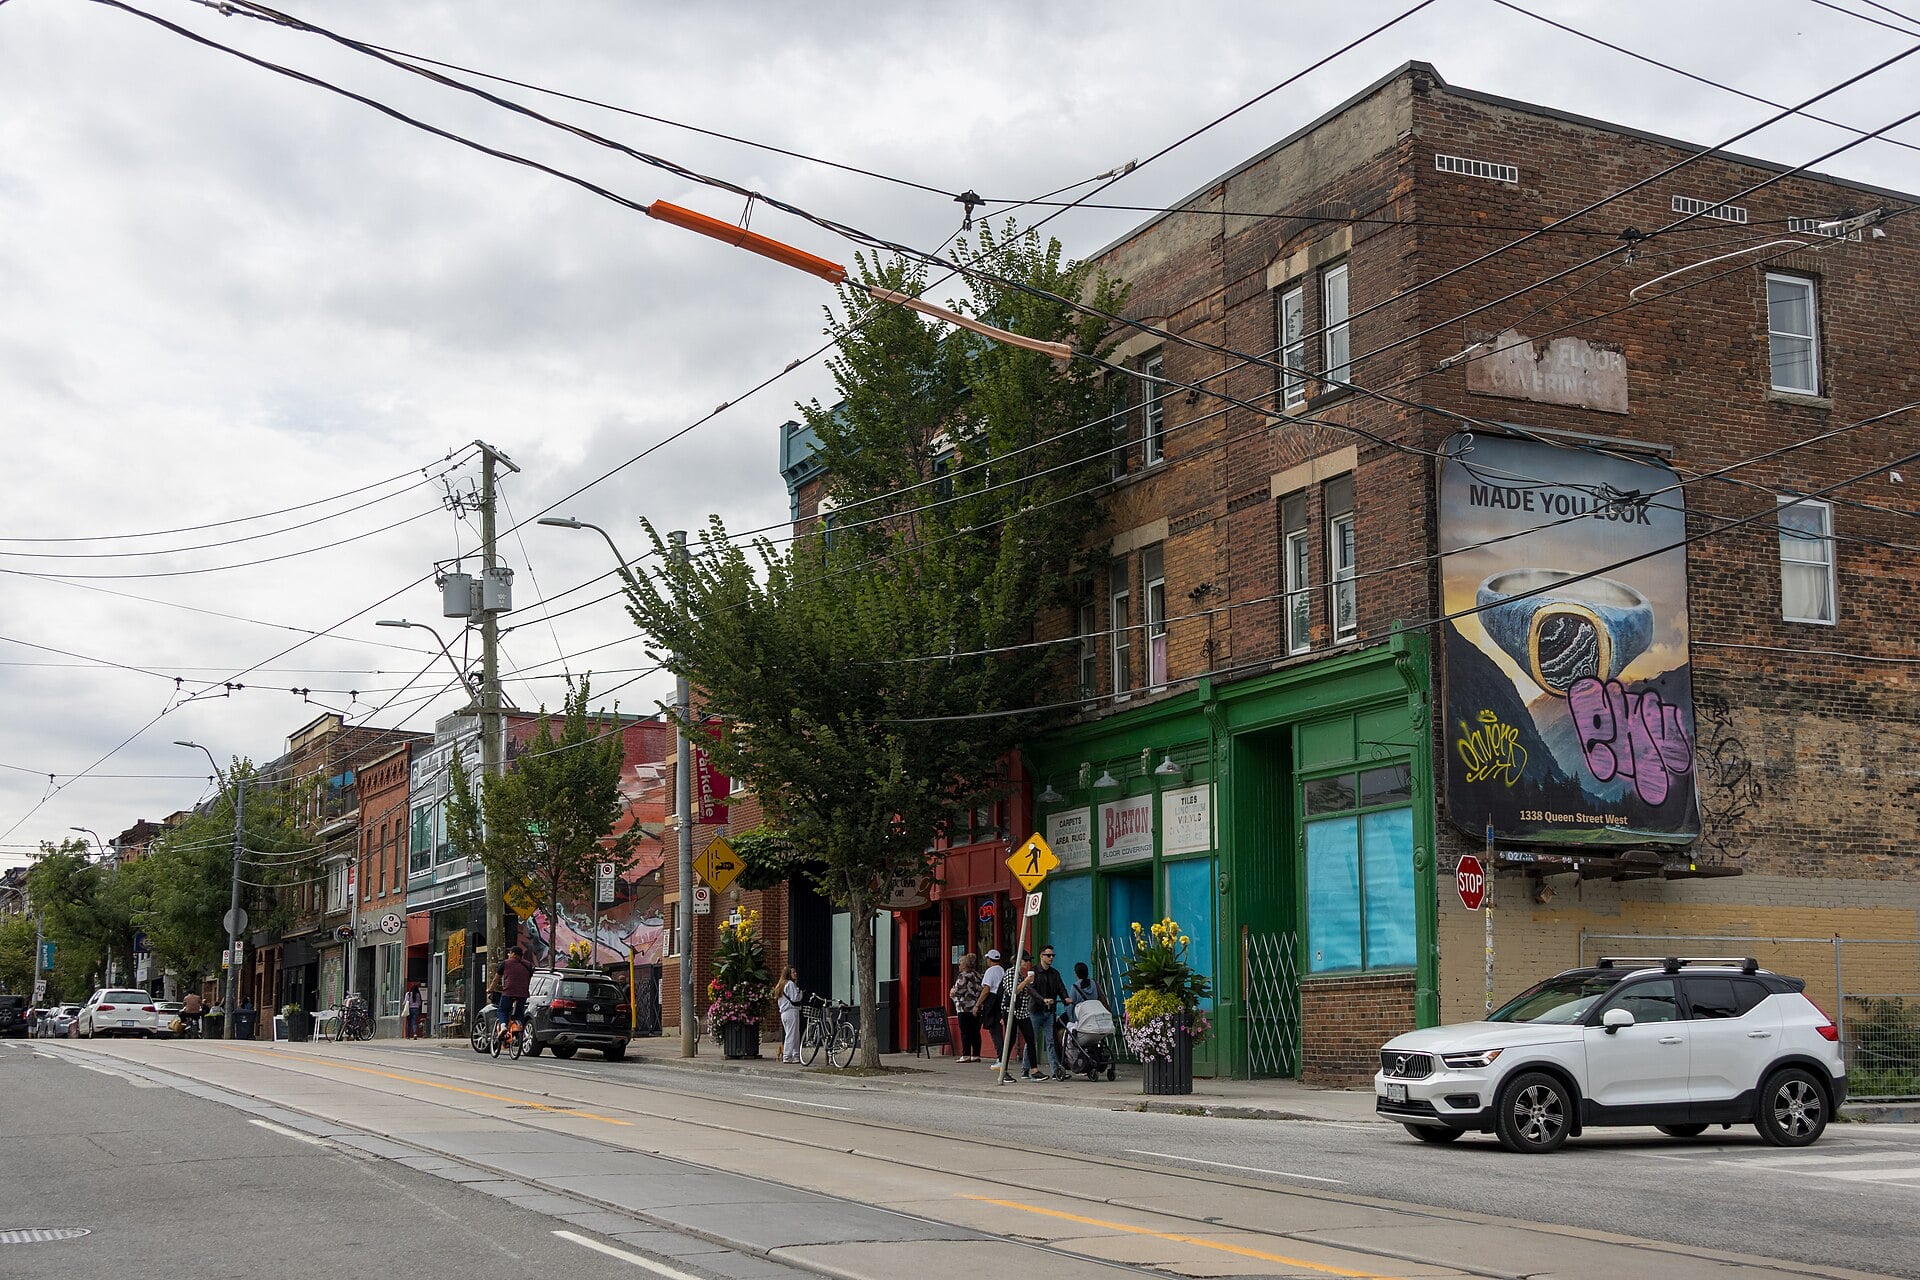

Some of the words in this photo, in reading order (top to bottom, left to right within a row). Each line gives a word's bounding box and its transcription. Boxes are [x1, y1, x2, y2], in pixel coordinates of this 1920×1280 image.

[1470, 484, 1535, 512] MADE
[1539, 492, 1586, 516] YOU
[697, 747, 714, 817] Parkdale
[1181, 795, 1197, 806] TILES
[1059, 816, 1082, 828] CARPETS
[1519, 810, 1543, 822] 1338
[1544, 811, 1574, 824] Queen
[1575, 813, 1604, 824] Street
[1605, 814, 1628, 825] West
[1105, 807, 1149, 848] BARTON
[1056, 836, 1069, 846] AREA
[1071, 833, 1086, 843] RUGS
[1103, 849, 1121, 859] FLOOR
[1121, 844, 1152, 856] COVERINGS
[1459, 872, 1483, 894] STOP
